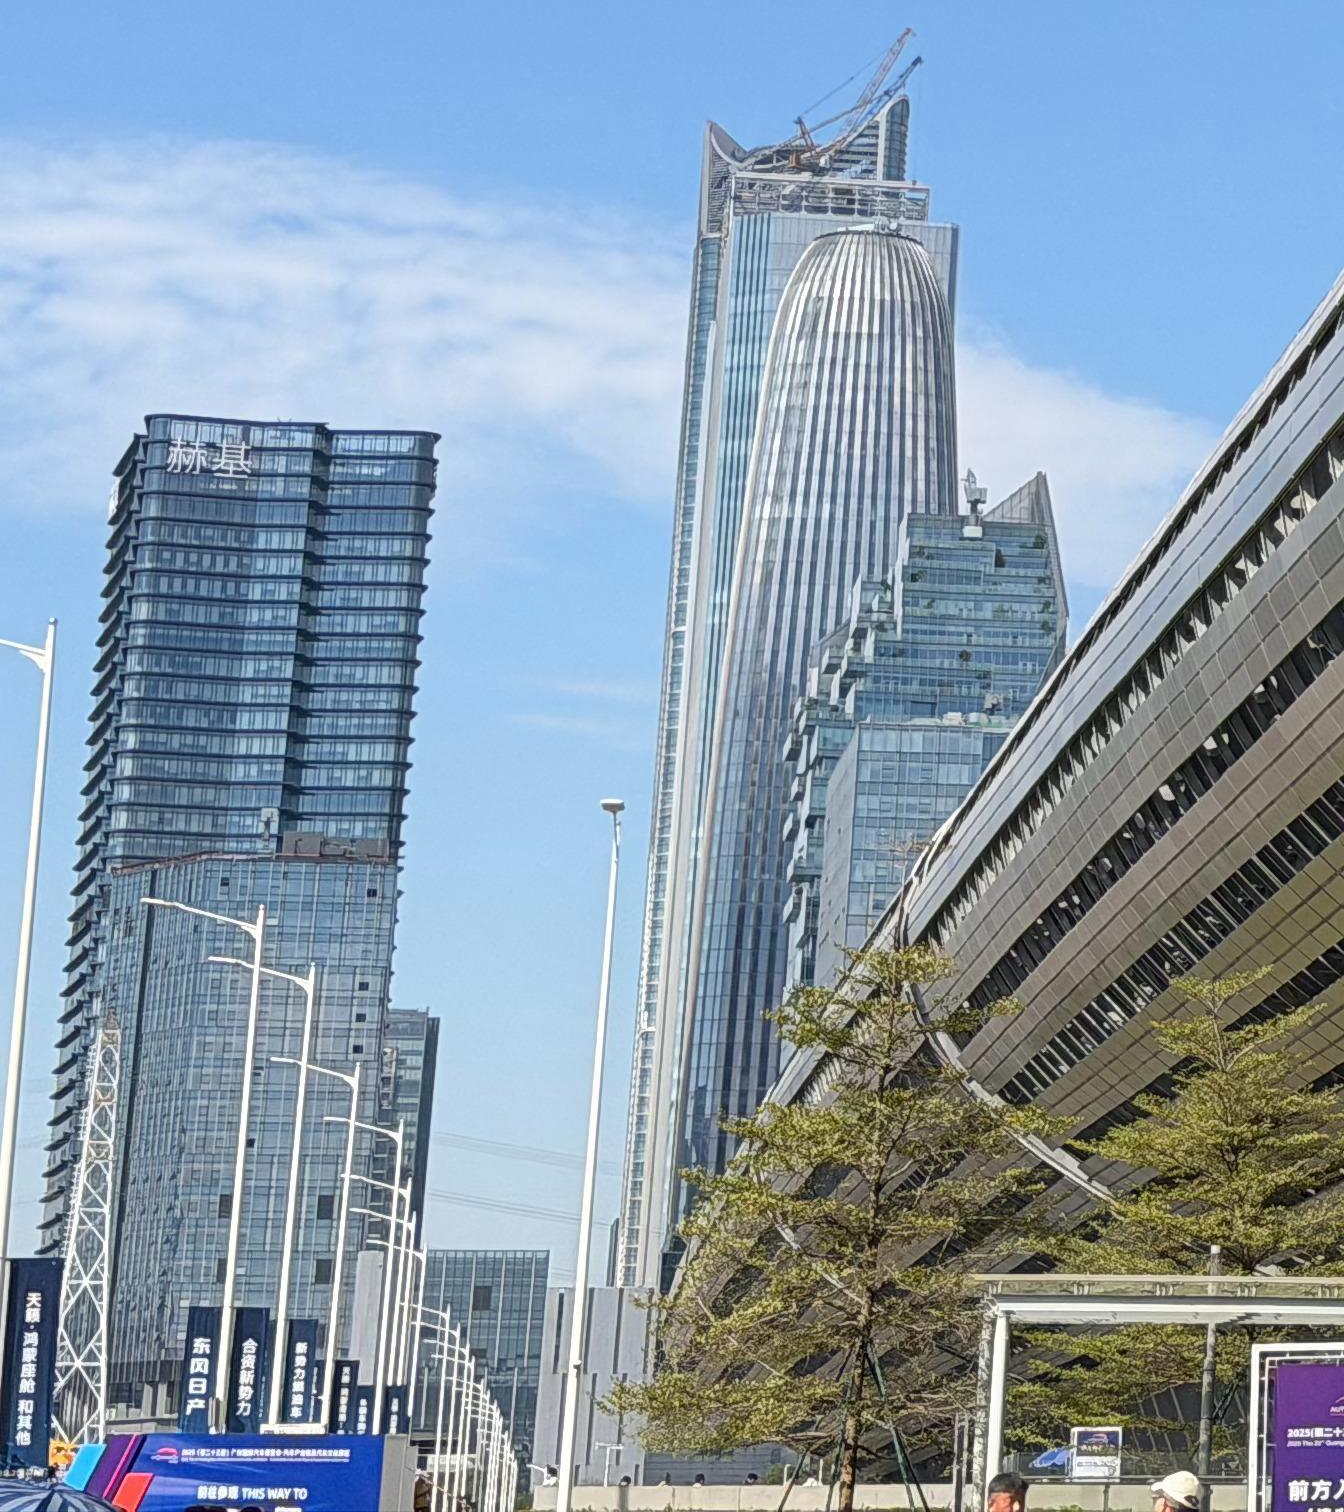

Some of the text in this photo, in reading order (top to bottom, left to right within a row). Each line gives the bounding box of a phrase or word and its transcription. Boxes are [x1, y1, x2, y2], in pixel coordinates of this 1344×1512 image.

[186, 1337, 211, 1416] 东风日产
[242, 1487, 265, 1500] THIS
[267, 1487, 291, 1500] WAY
[293, 1487, 308, 1500] TO
